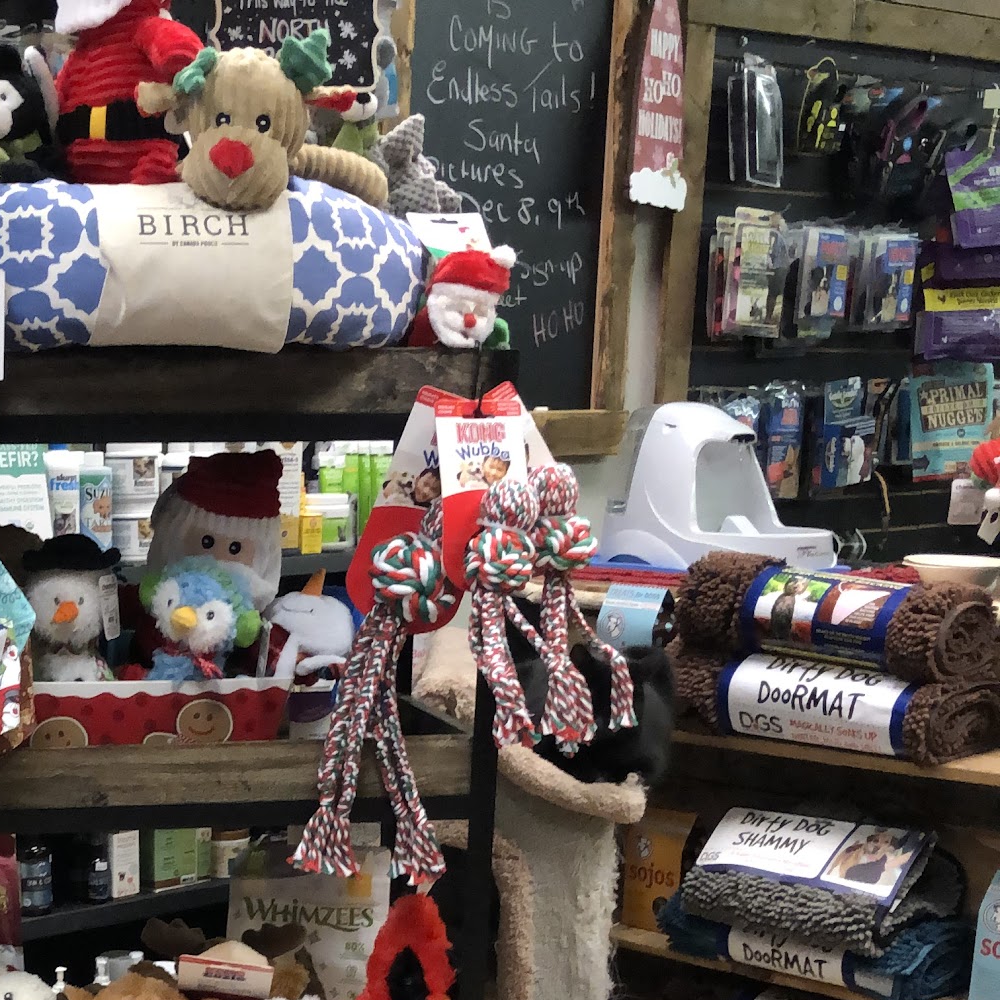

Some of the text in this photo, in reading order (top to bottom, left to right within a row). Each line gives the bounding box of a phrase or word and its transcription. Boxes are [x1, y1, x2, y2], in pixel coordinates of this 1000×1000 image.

[552, 21, 585, 63] to
[650, 28, 681, 63] HAPPY
[427, 60, 518, 109] Endless
[643, 70, 681, 104] HO HO
[464, 118, 540, 164] Santa
[137, 214, 250, 236] BIRCH
[928, 382, 985, 404] PRIMAL
[455, 422, 506, 444] KONG
[455, 442, 511, 463] Wubba
[738, 711, 784, 734] DGS
[740, 811, 791, 833] Dirty
[732, 831, 811, 855] SHAMMY
[628, 863, 675, 889] sojos
